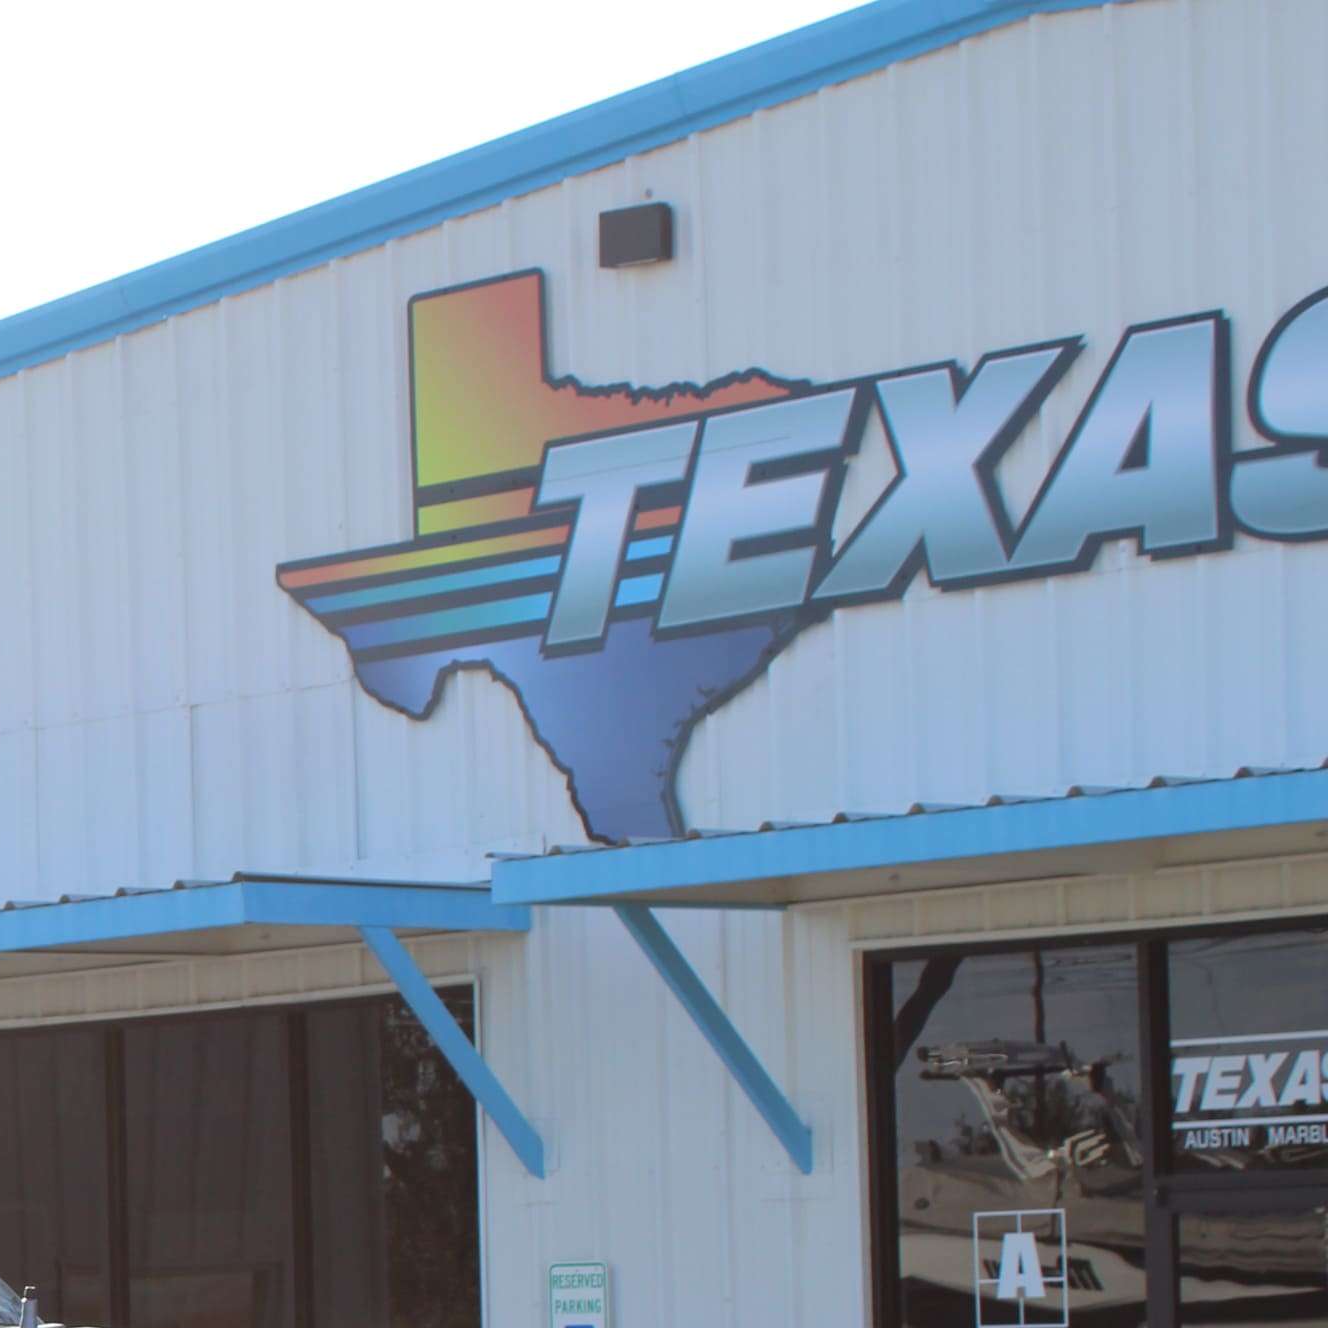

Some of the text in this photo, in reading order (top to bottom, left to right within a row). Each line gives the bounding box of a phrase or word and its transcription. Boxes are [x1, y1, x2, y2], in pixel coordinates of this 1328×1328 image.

[1172, 1049, 1328, 1114] TEXA
[1184, 1128, 1250, 1149] AUSTIN
[552, 1273, 605, 1289] RESERVED
[554, 1299, 602, 1314] PARKING
